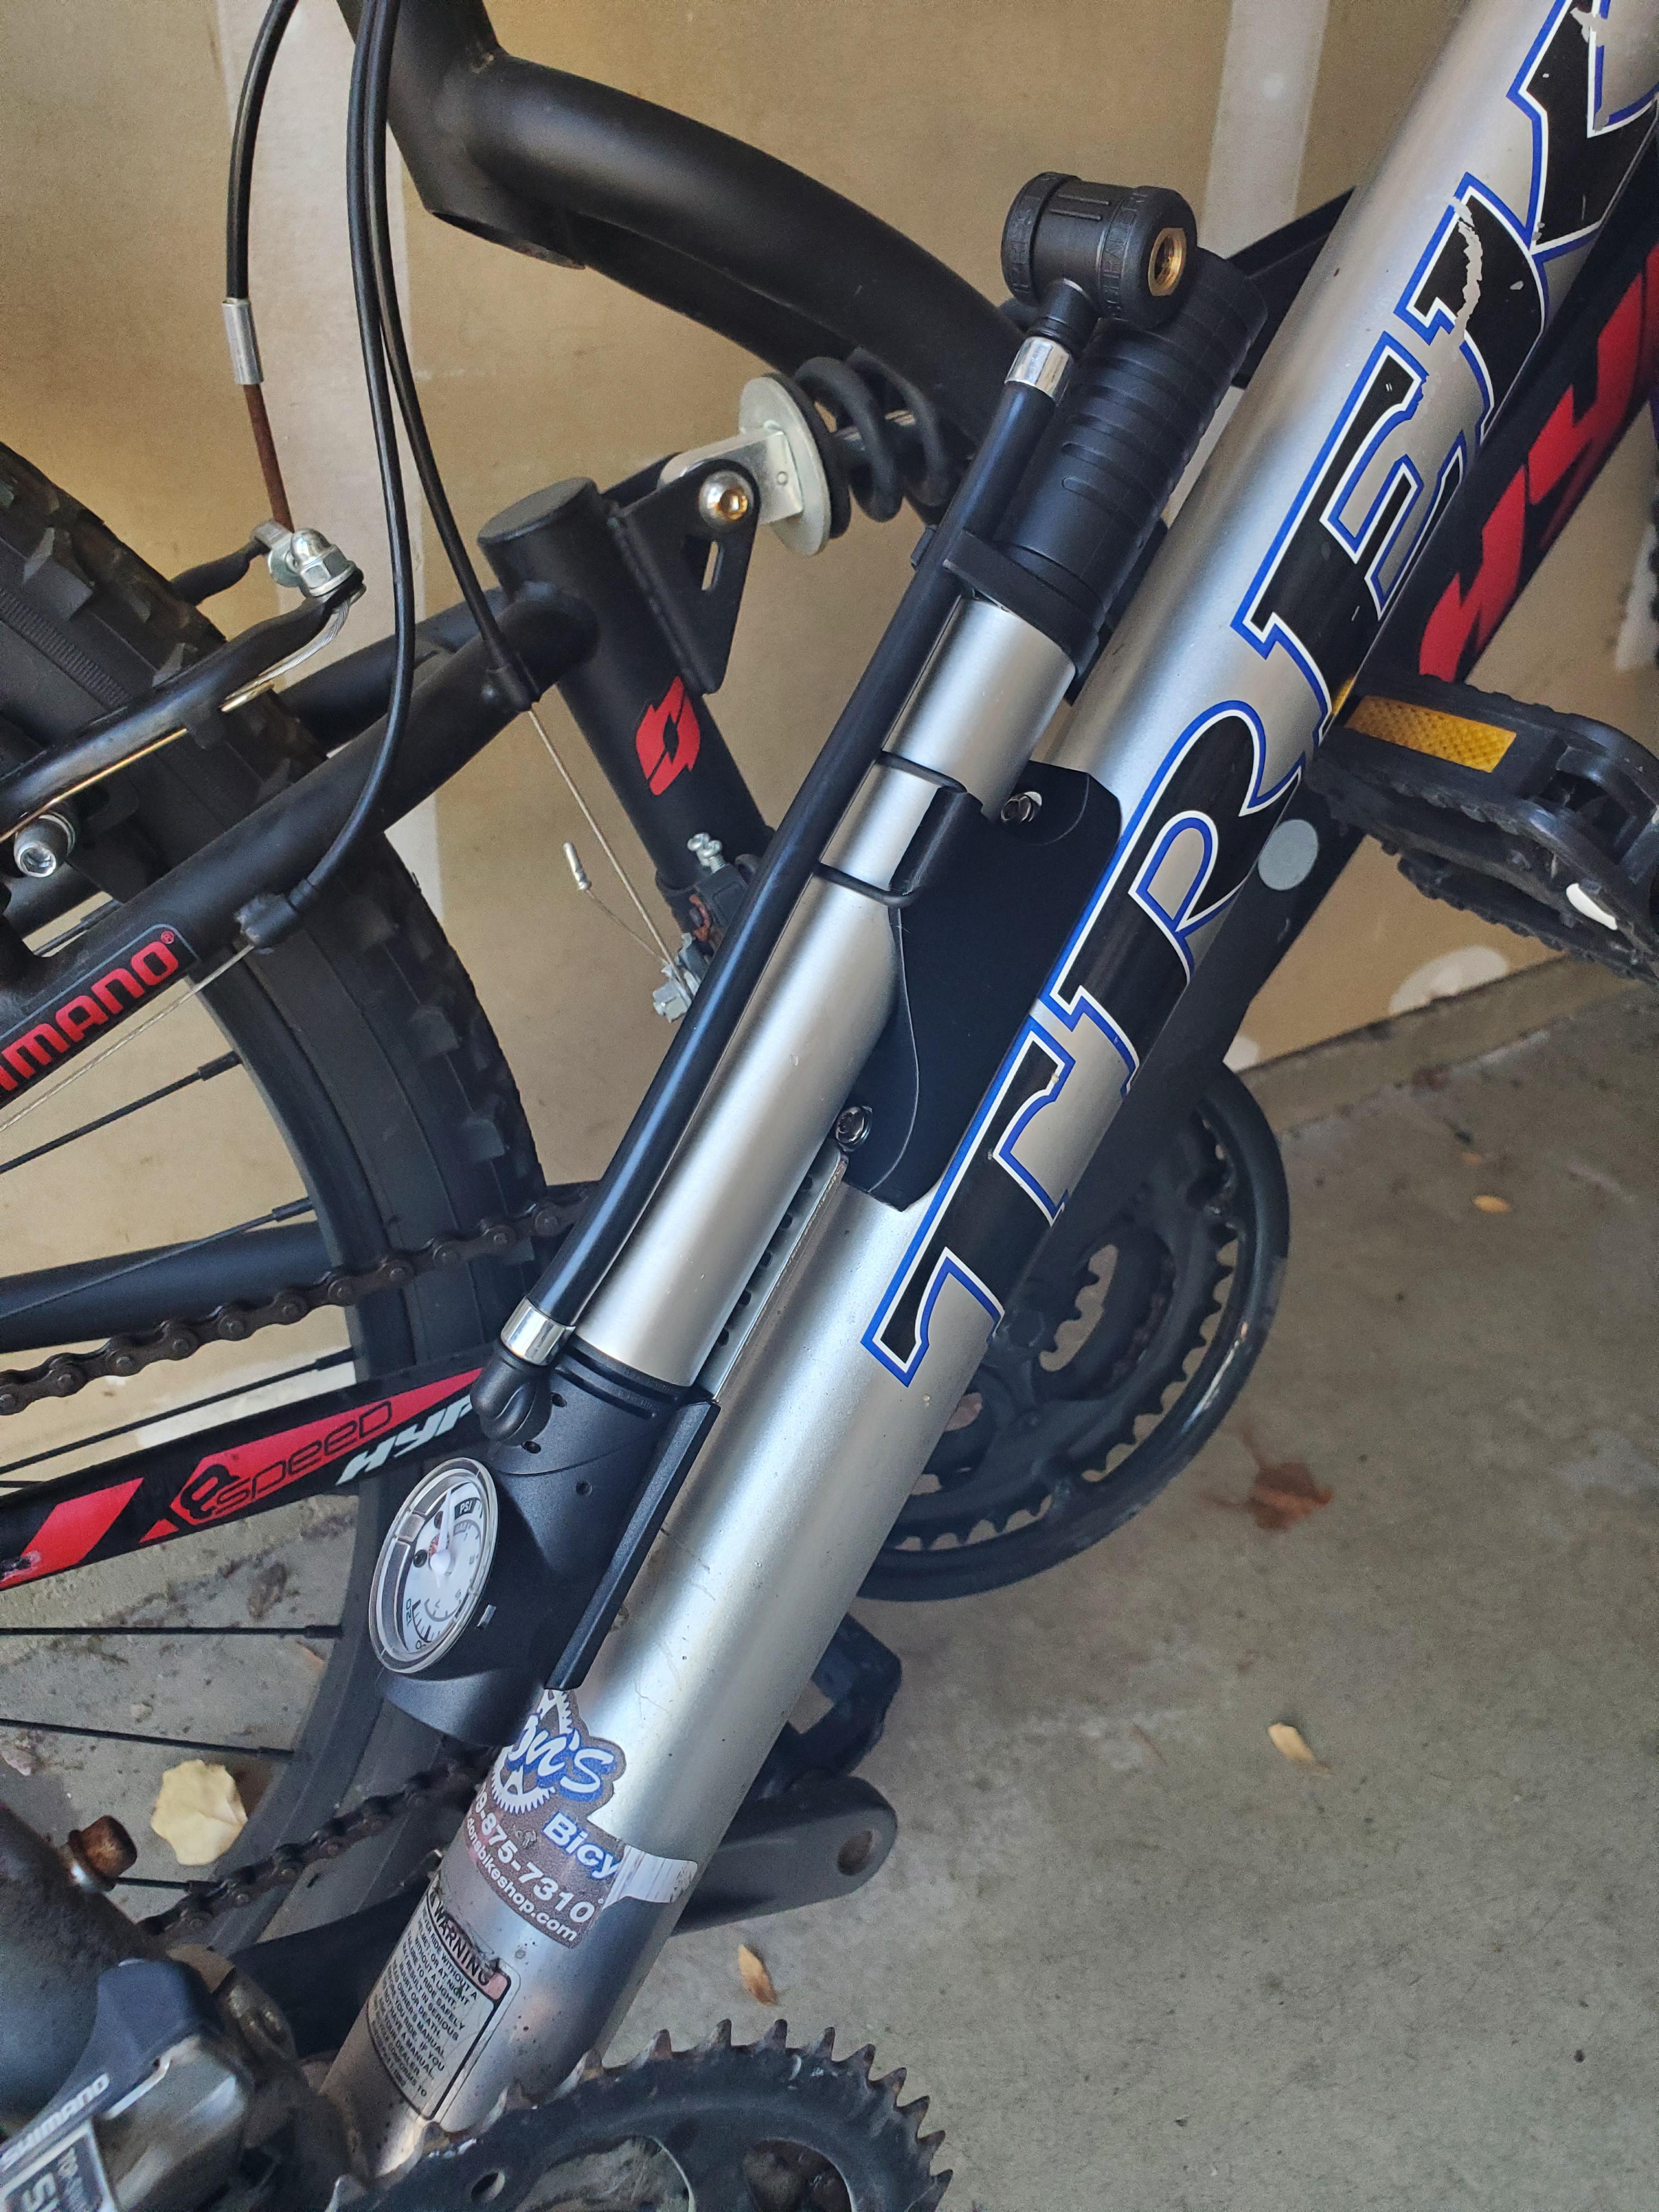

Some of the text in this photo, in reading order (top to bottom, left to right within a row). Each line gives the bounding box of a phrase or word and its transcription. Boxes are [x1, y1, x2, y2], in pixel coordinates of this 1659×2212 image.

[860, 0, 1659, 1386] TREK
[460, 1500, 473, 1514] PSI
[430, 1934, 442, 1954] RIDE
[442, 1954, 470, 1991] WITHOUT
[431, 1954, 439, 1968] OR
[438, 1969, 447, 1979] AT
[447, 1979, 470, 2005] NIGHT
[405, 1960, 422, 1990] RESULT
[427, 2002, 460, 2040] SERIOUS
[422, 1977, 436, 1999] RIDE
[436, 1997, 465, 2030] SAFELY
[416, 2021, 444, 2059] MANUAL
[428, 2050, 445, 2071] YOU
[0, 2073, 110, 2172] SHIMANO
